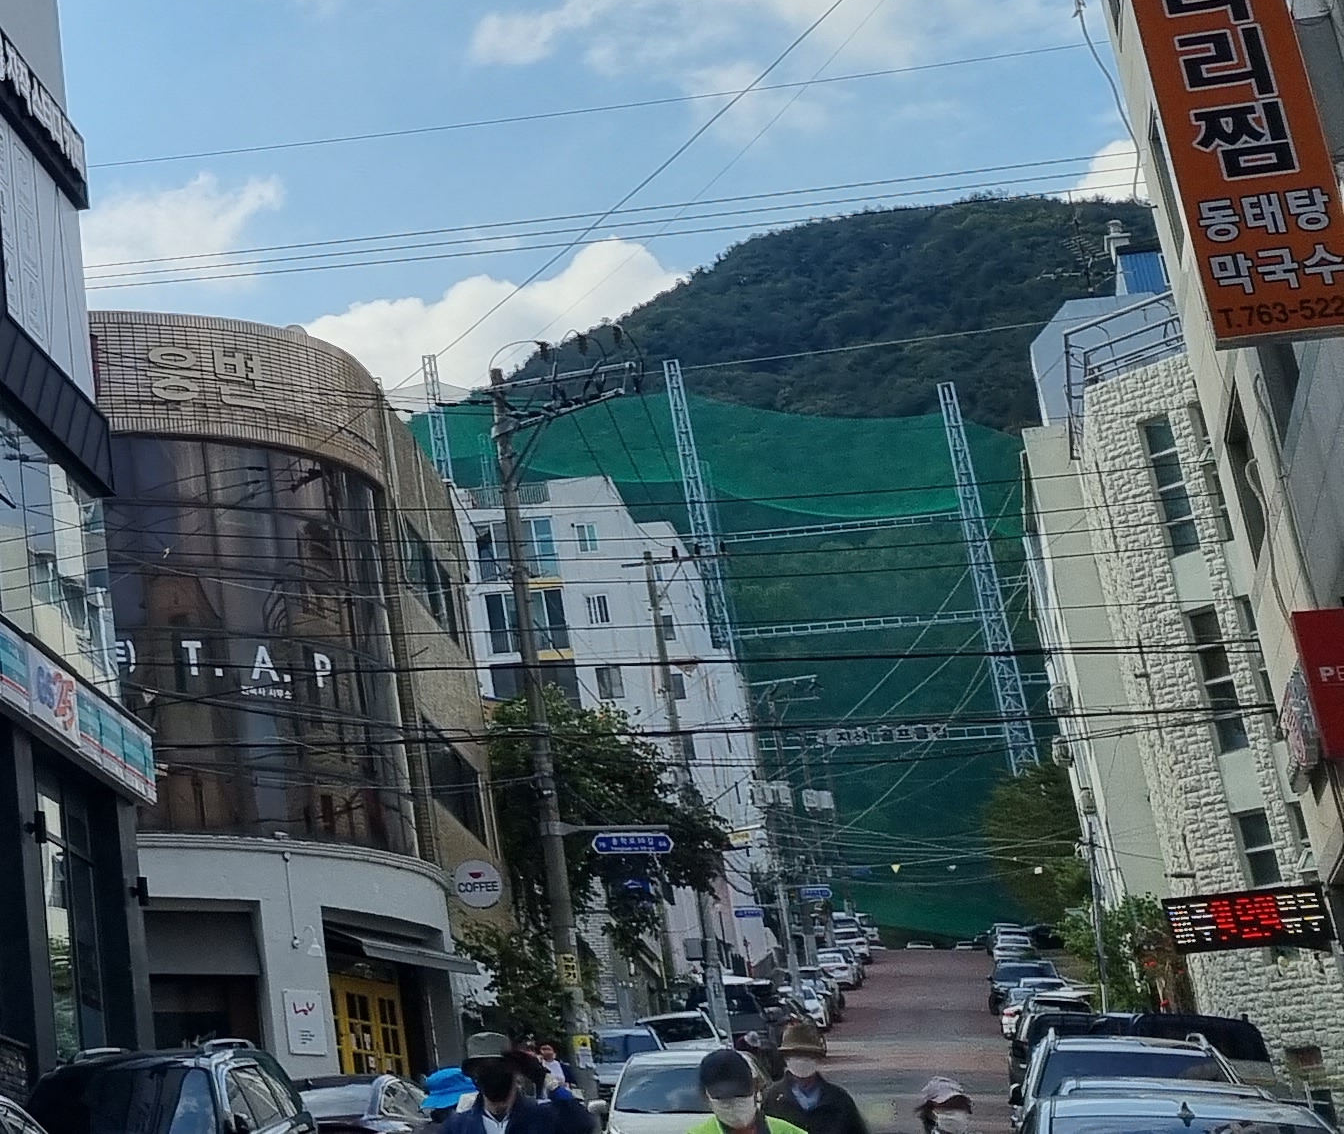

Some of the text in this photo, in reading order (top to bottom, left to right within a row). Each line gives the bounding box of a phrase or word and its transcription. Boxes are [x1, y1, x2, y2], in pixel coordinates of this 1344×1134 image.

[1198, 187, 1330, 243] 동태탕
[1208, 242, 1344, 295] 막국수
[458, 880, 499, 894] COFFEE
